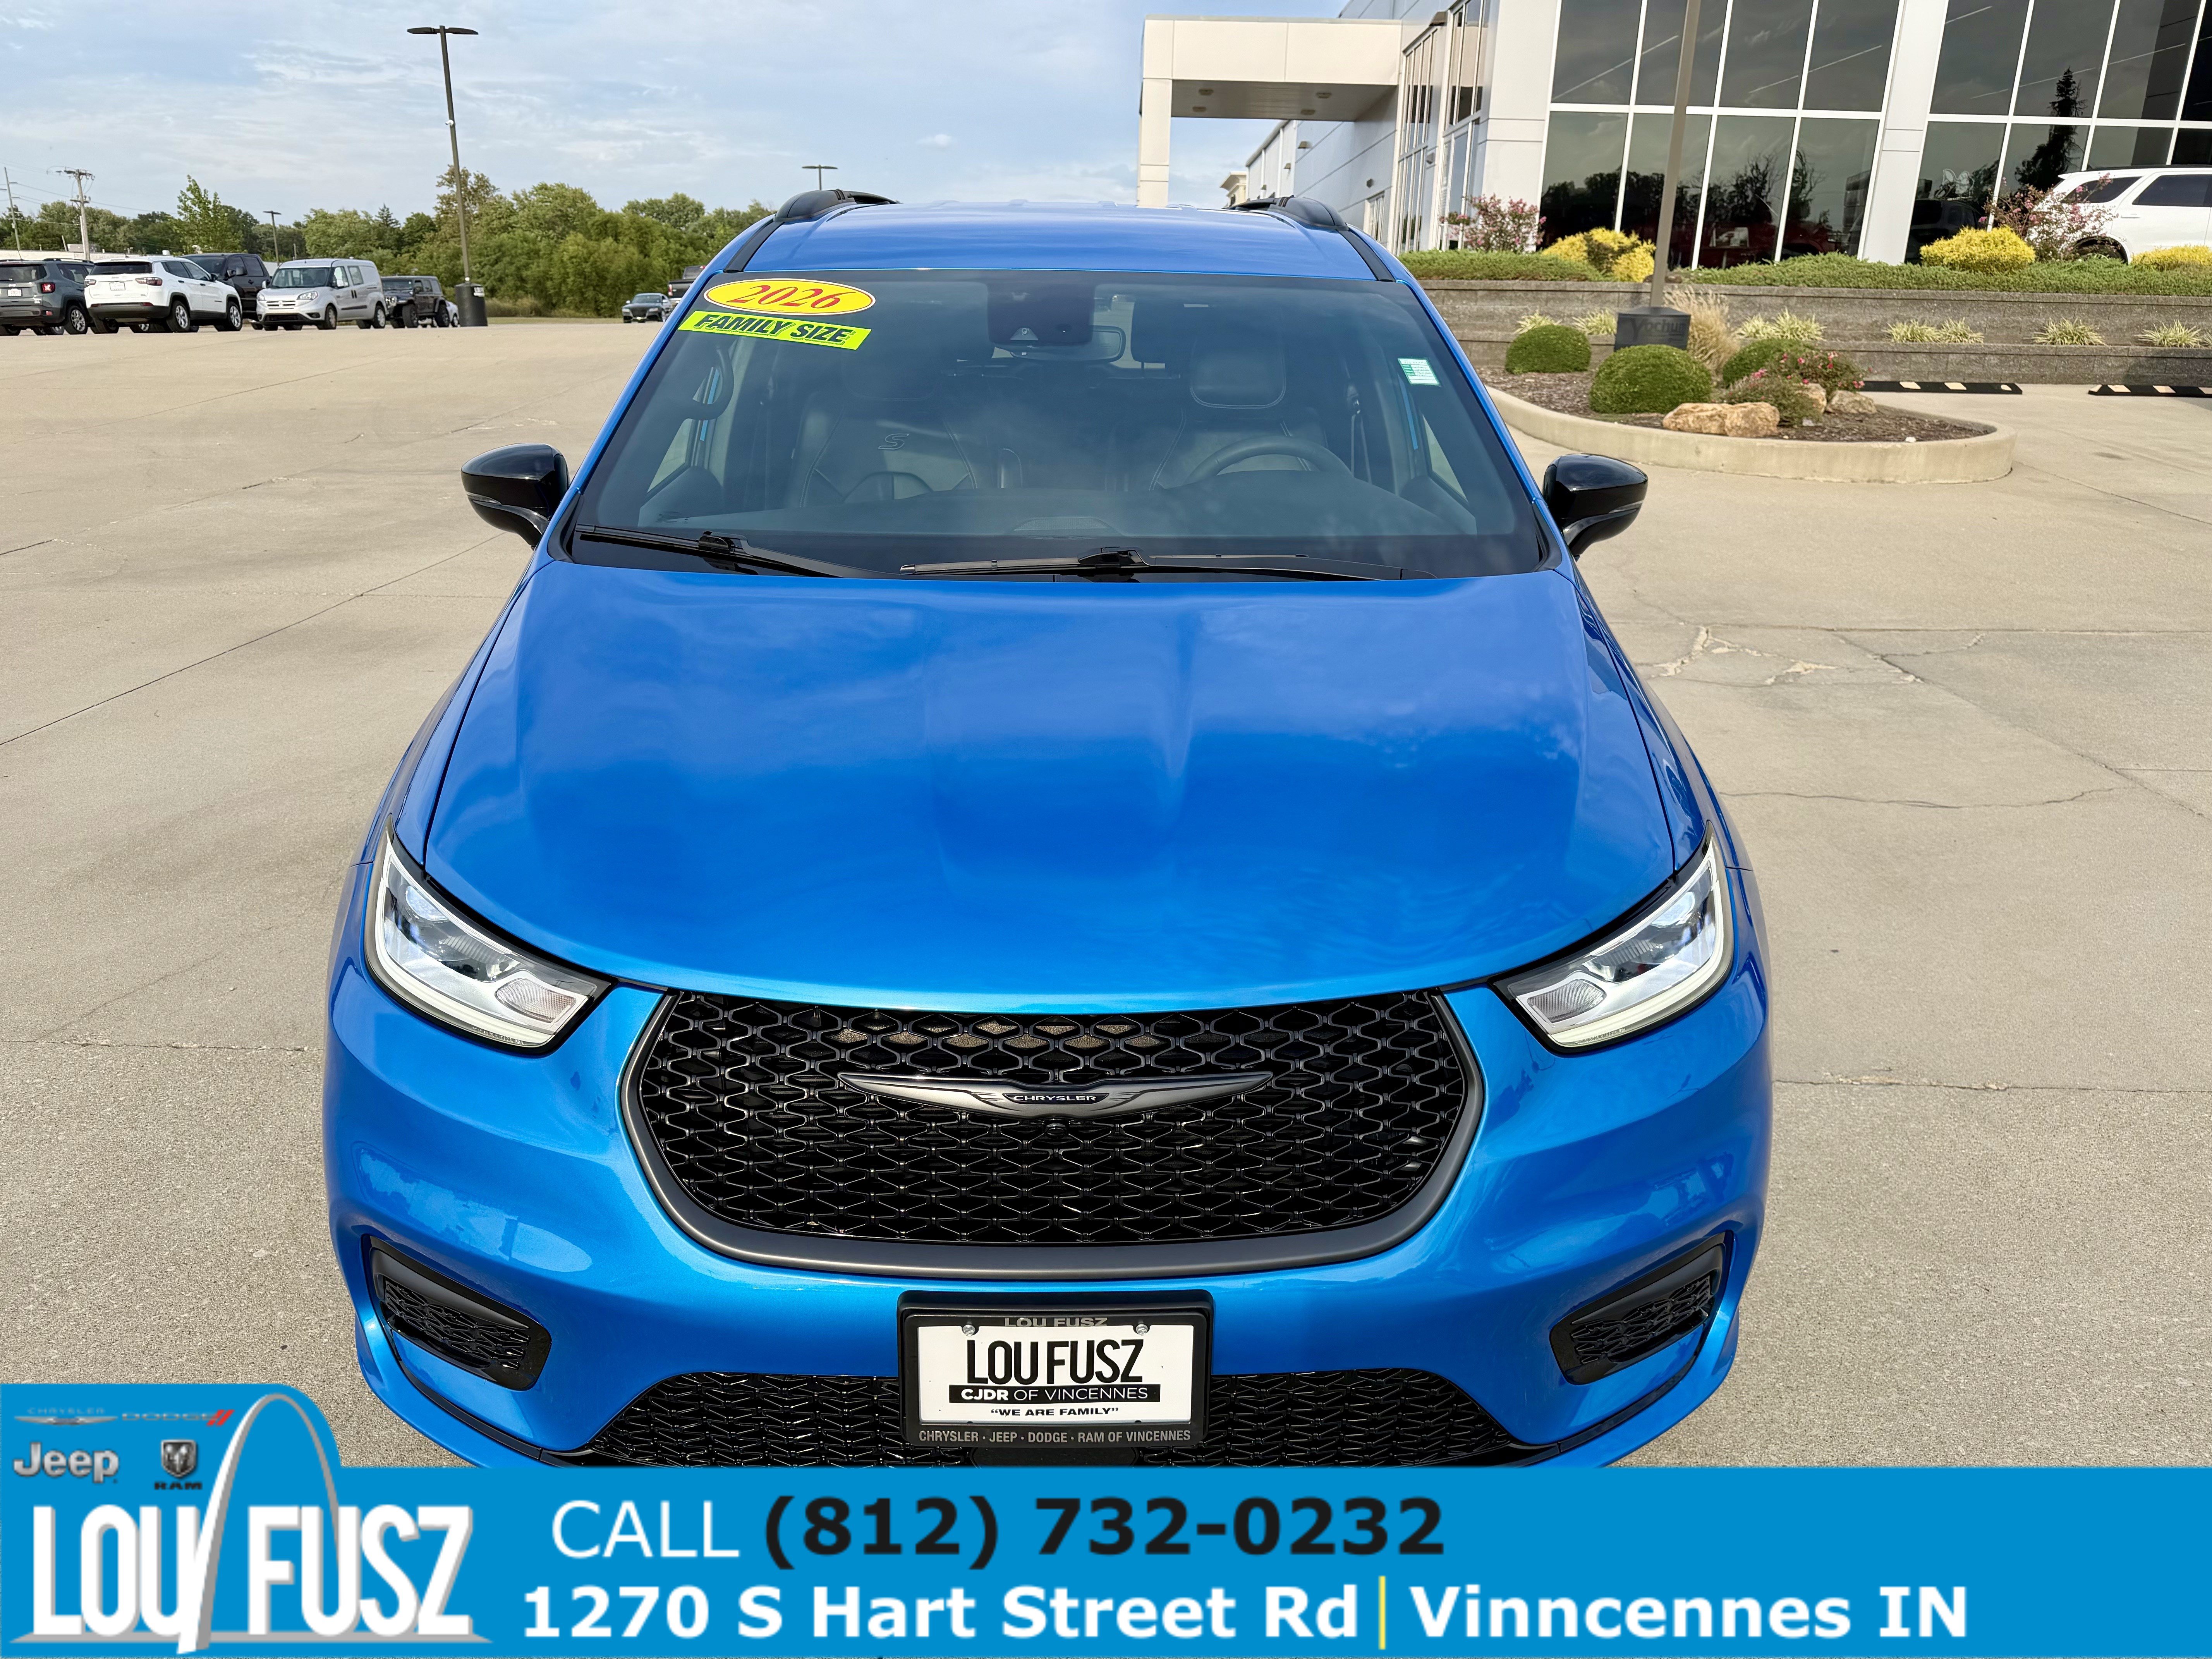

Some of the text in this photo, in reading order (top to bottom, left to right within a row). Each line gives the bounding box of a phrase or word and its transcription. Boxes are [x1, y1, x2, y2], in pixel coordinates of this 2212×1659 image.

[725, 285, 856, 309] 2026
[693, 314, 856, 345] FAMILY SIZE
[1004, 1317, 1108, 1327] LOU FUSZ
[967, 1339, 1144, 1385] LOU FUSZ
[961, 1388, 1148, 1401] CJDR OF VINCENNES
[919, 1430, 1190, 1443] CHRYSLER JEEP DODGE RAM OF VINCENNES
